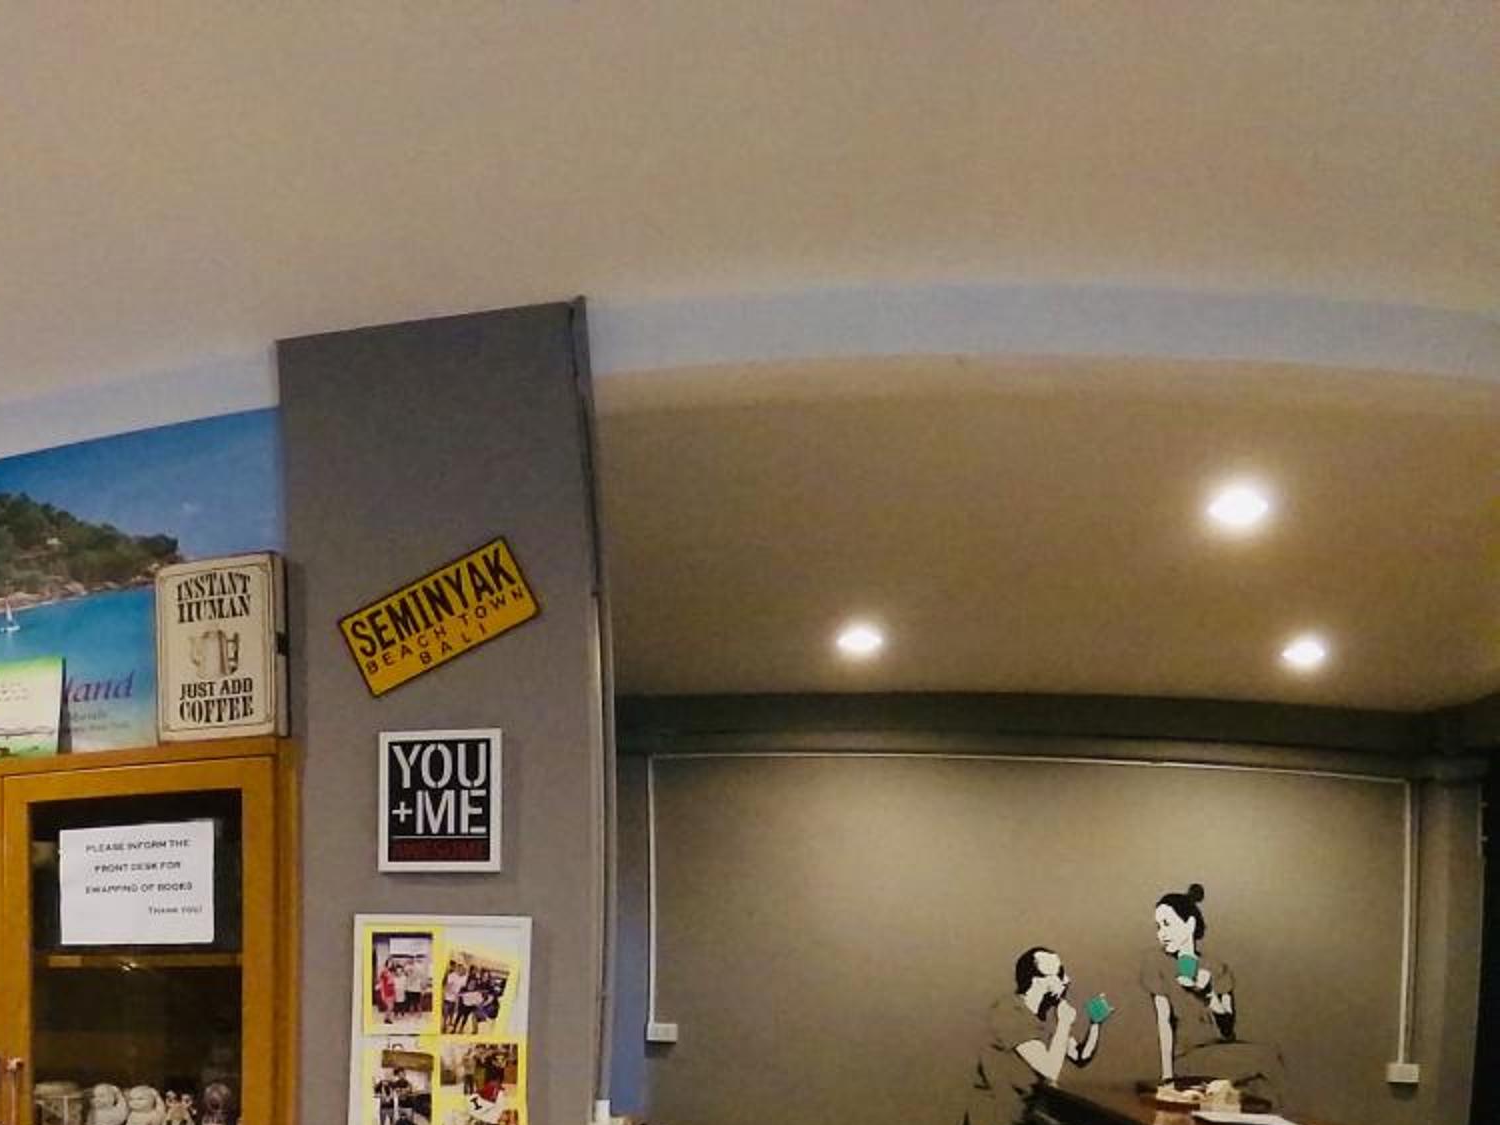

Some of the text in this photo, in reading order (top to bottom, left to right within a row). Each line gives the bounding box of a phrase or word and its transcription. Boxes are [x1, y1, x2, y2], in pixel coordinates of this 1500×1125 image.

[176, 570, 251, 602] INSTANT
[177, 595, 251, 624] HUMAN
[351, 548, 517, 657] SEMINYAK
[365, 585, 525, 675] BEACH TOWN
[419, 623, 487, 665] BALI
[180, 677, 254, 700] JUST ADD
[179, 696, 254, 724] COFFEE
[392, 743, 487, 789] YOU
[86, 839, 190, 853] PLEASE INFORM THE
[94, 861, 181, 873] FRONT DESK FOR
[85, 881, 193, 895] SWAPPING OF BOOKS
